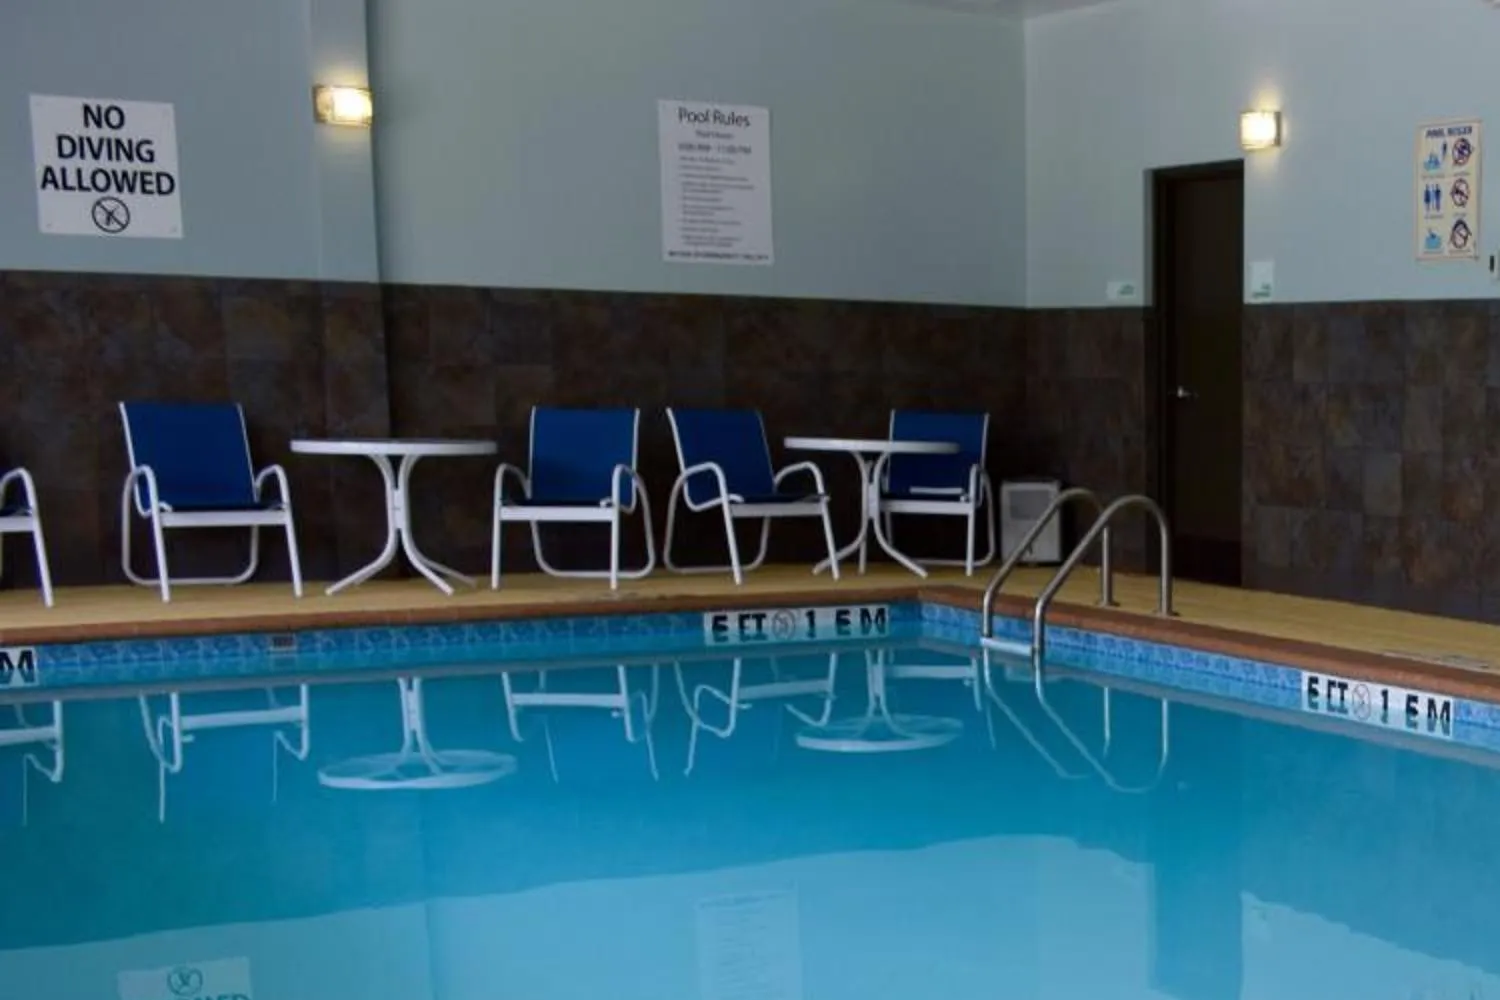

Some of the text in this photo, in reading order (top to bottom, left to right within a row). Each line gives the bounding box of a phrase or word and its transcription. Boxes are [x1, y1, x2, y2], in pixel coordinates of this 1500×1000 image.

[82, 103, 125, 130] NO
[678, 106, 750, 128] Pool Rules
[56, 133, 156, 163] DIVING
[40, 165, 176, 196] ALLOWED
